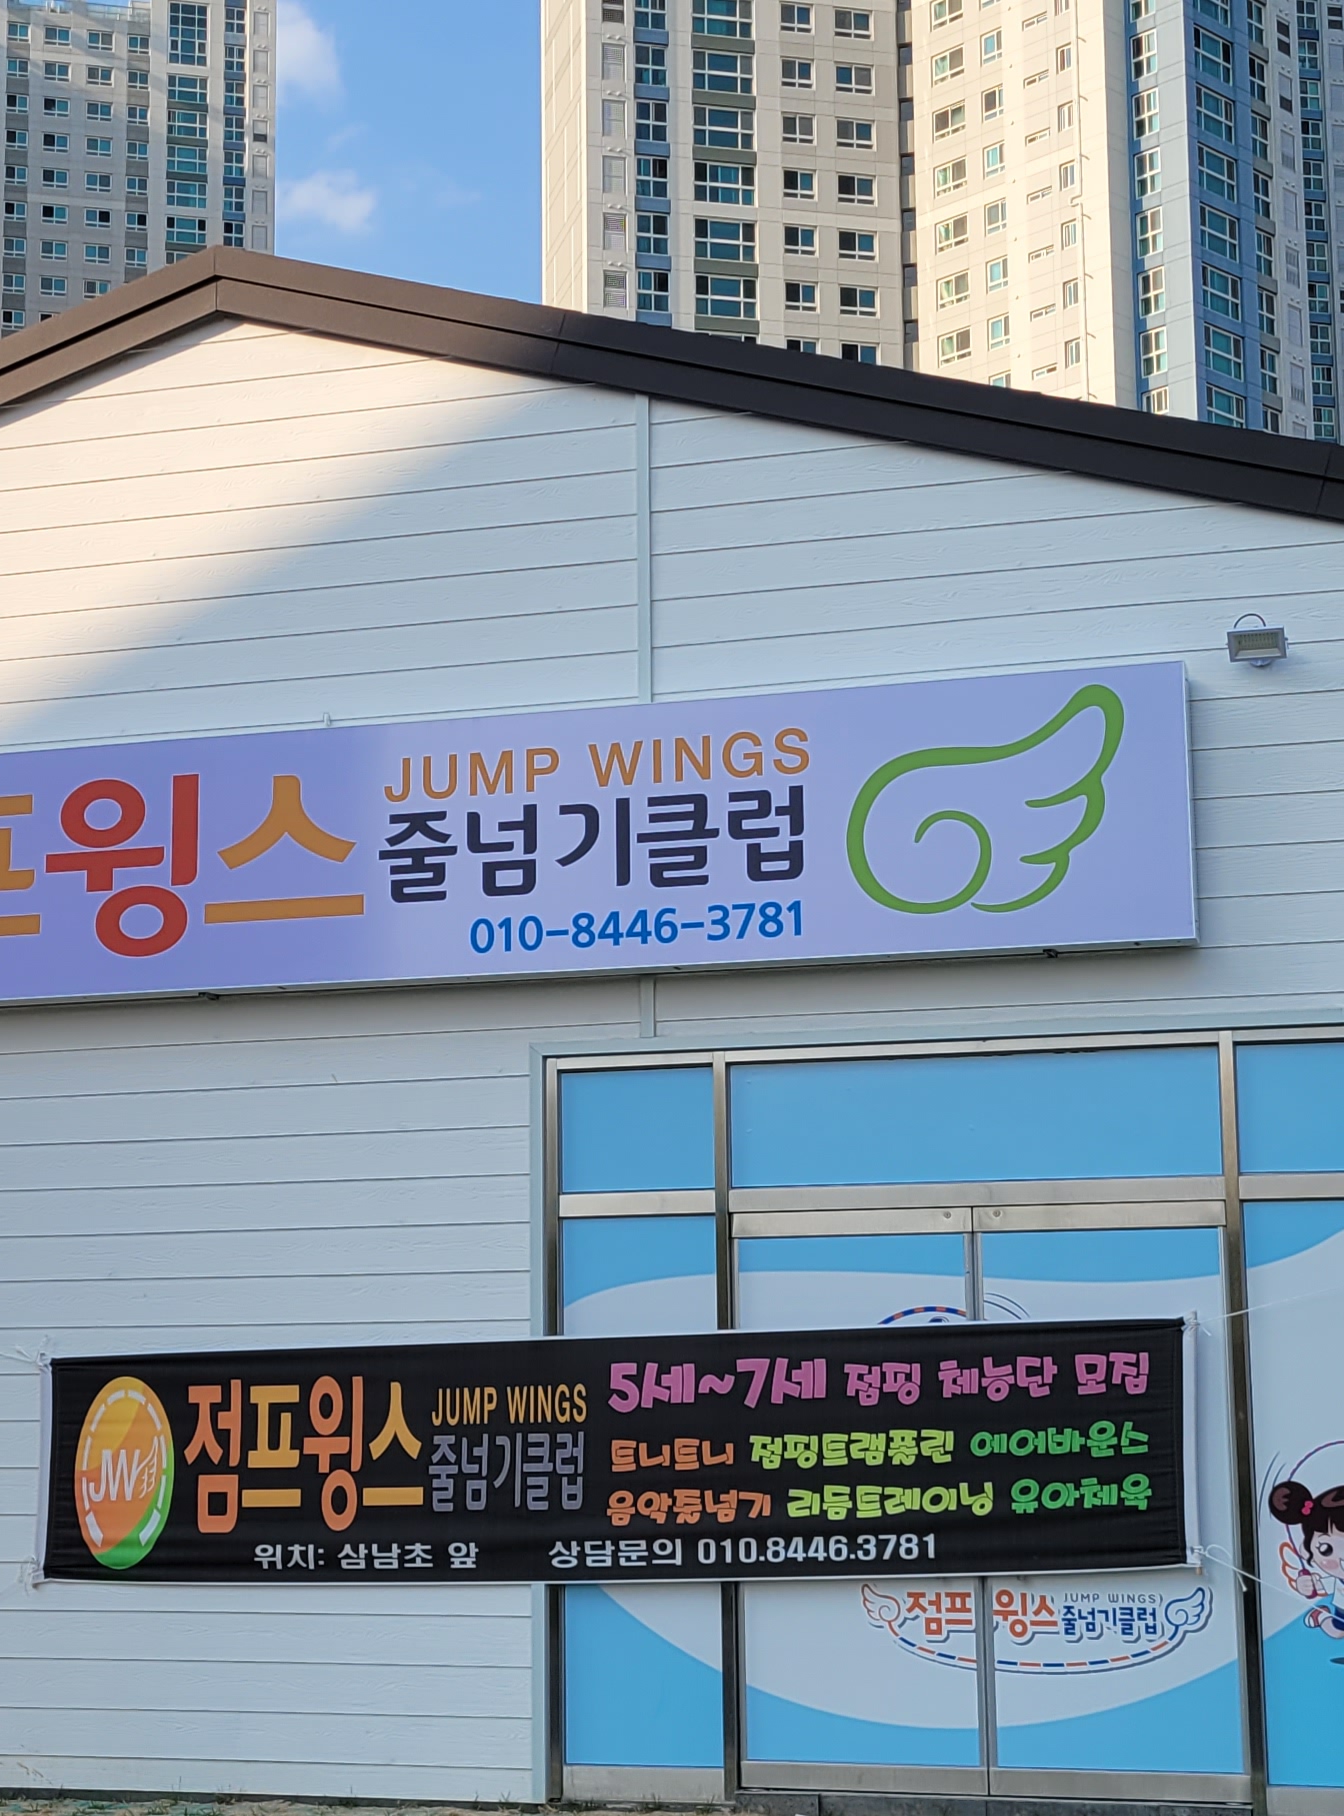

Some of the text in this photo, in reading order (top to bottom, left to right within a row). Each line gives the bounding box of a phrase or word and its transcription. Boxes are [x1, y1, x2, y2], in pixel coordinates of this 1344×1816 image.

[384, 727, 812, 803] JUMP WINGS
[378, 785, 806, 905] 줄넘기클럽
[469, 899, 805, 955] 010-8446-3781
[431, 1383, 588, 1427] JUMP WINGS
[607, 1351, 1150, 1413] 5세~7세 점핑 체능단 모집
[183, 1375, 424, 1534] 점프윙스
[428, 1431, 585, 1513] 줄넘기클럽
[611, 1420, 1150, 1472] 트니트니 점핑트램폴린 에어바운스
[606, 1473, 1153, 1527] 음악줄넘기 리듬트레이닝 유아체육
[253, 1540, 479, 1570] 위치: 삼남초 앞
[548, 1533, 937, 1569] 상담문의 010.8446.3781
[905, 1588, 1058, 1638] 점프윙스
[1061, 1605, 1158, 1636] 줄넘기클럽
[1063, 1593, 1157, 1604] JUMP WINGS
